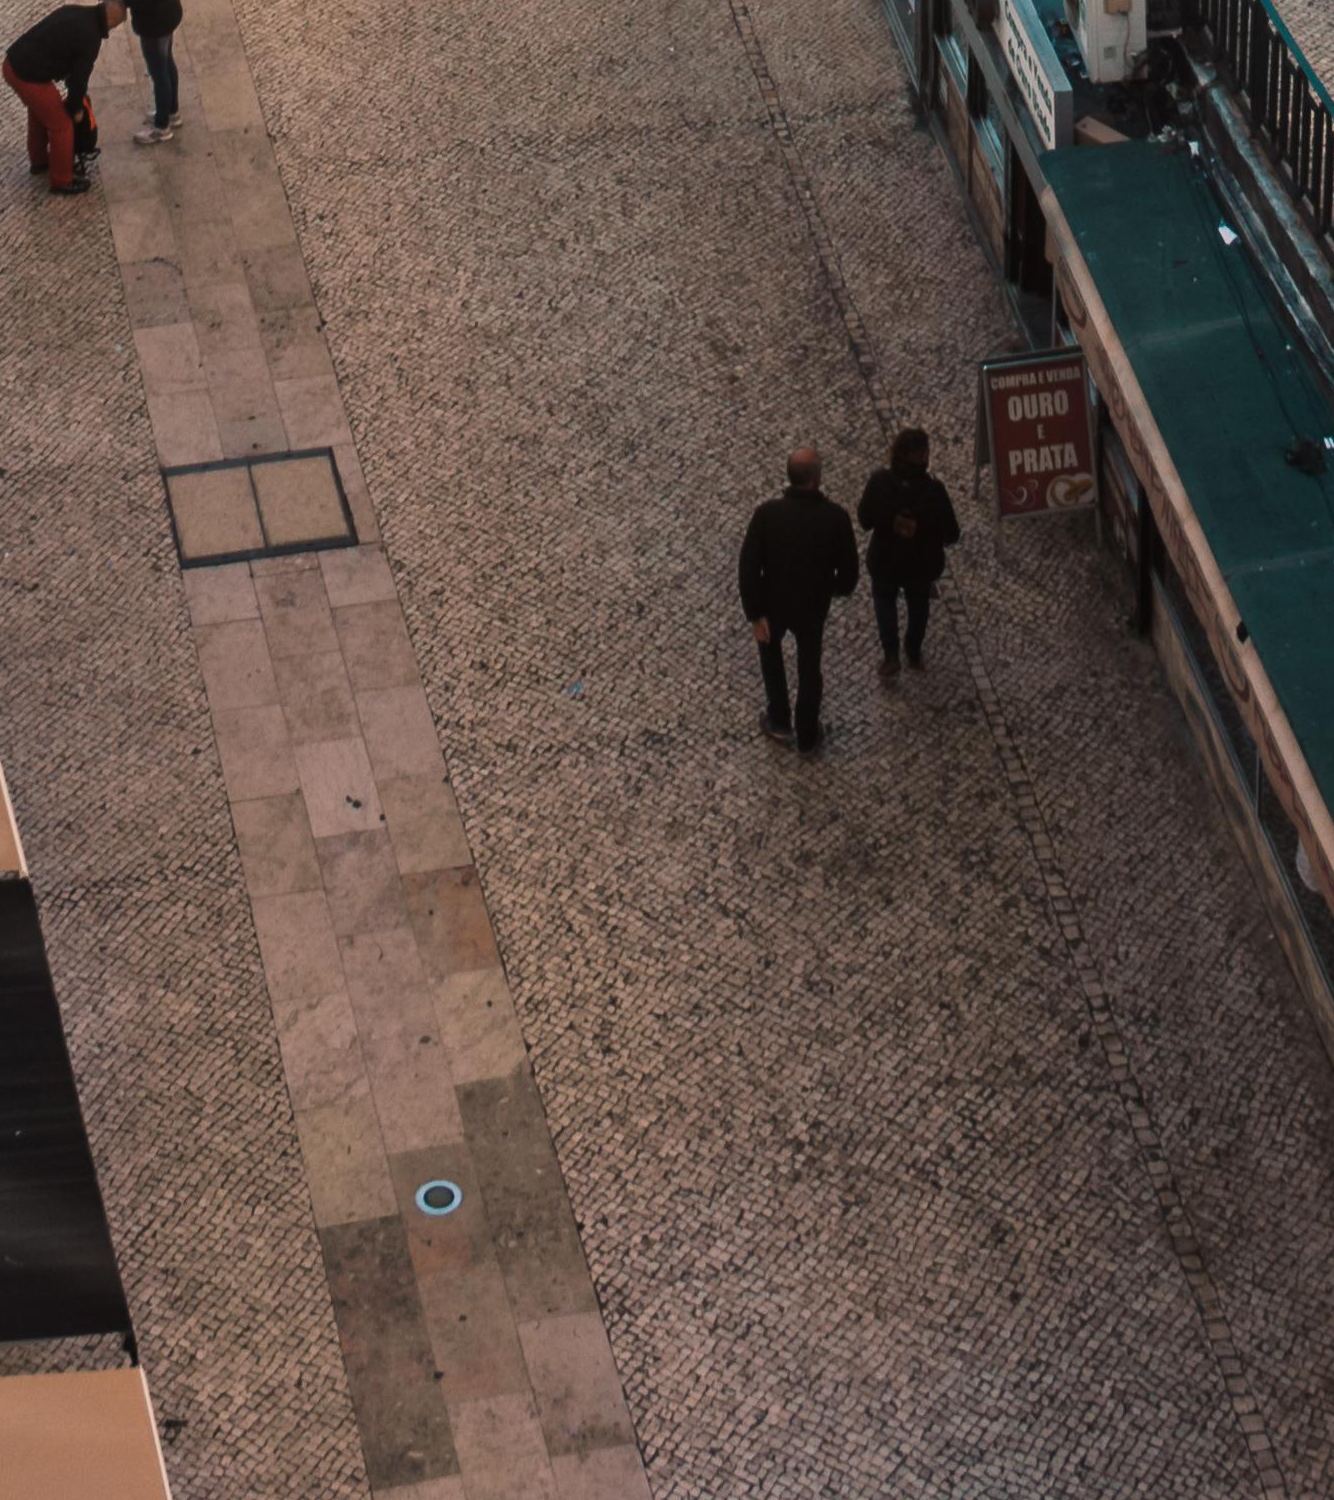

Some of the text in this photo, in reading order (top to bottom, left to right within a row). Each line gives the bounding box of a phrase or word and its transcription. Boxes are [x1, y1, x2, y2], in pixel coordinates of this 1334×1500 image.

[990, 366, 1082, 390] COMPRA E VENDA
[1008, 389, 1069, 422] OURO
[1036, 423, 1046, 440] E
[1008, 442, 1079, 477] PRATA
